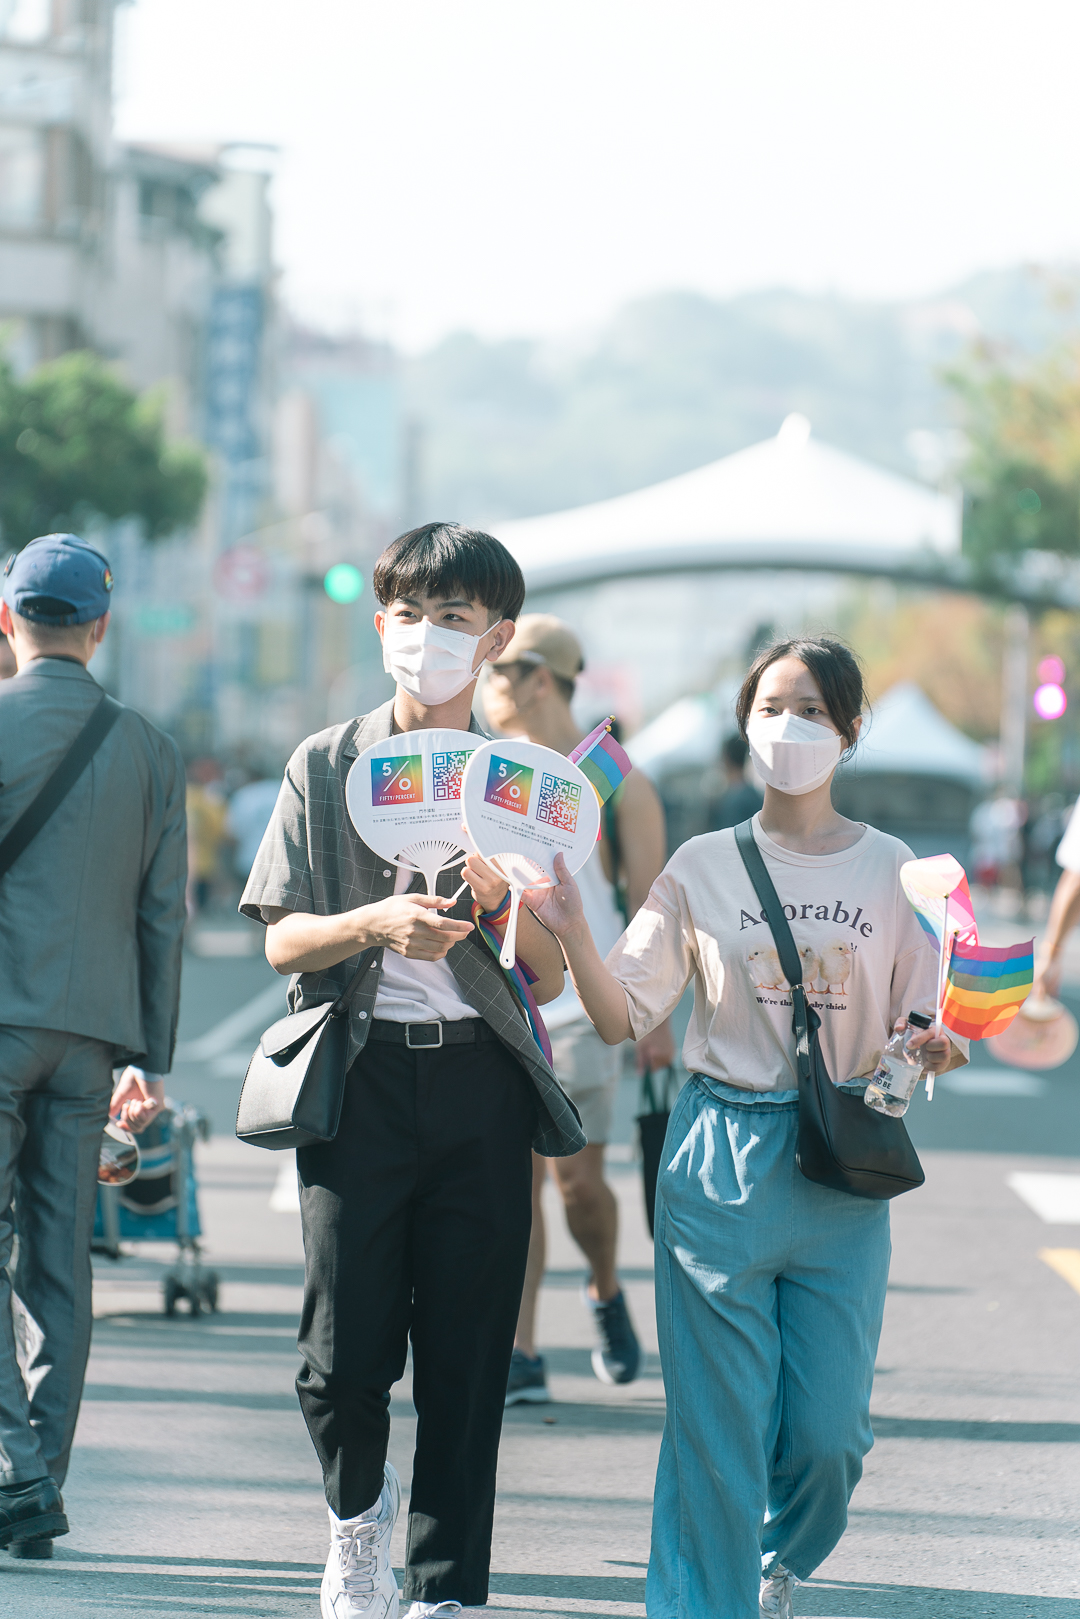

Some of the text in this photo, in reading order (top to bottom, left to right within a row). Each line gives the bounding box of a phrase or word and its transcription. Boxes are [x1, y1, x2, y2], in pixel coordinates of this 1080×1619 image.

[755, 996, 778, 1006] We're
[809, 1001, 824, 1010] aby
[882, 1081, 892, 1090] BE
